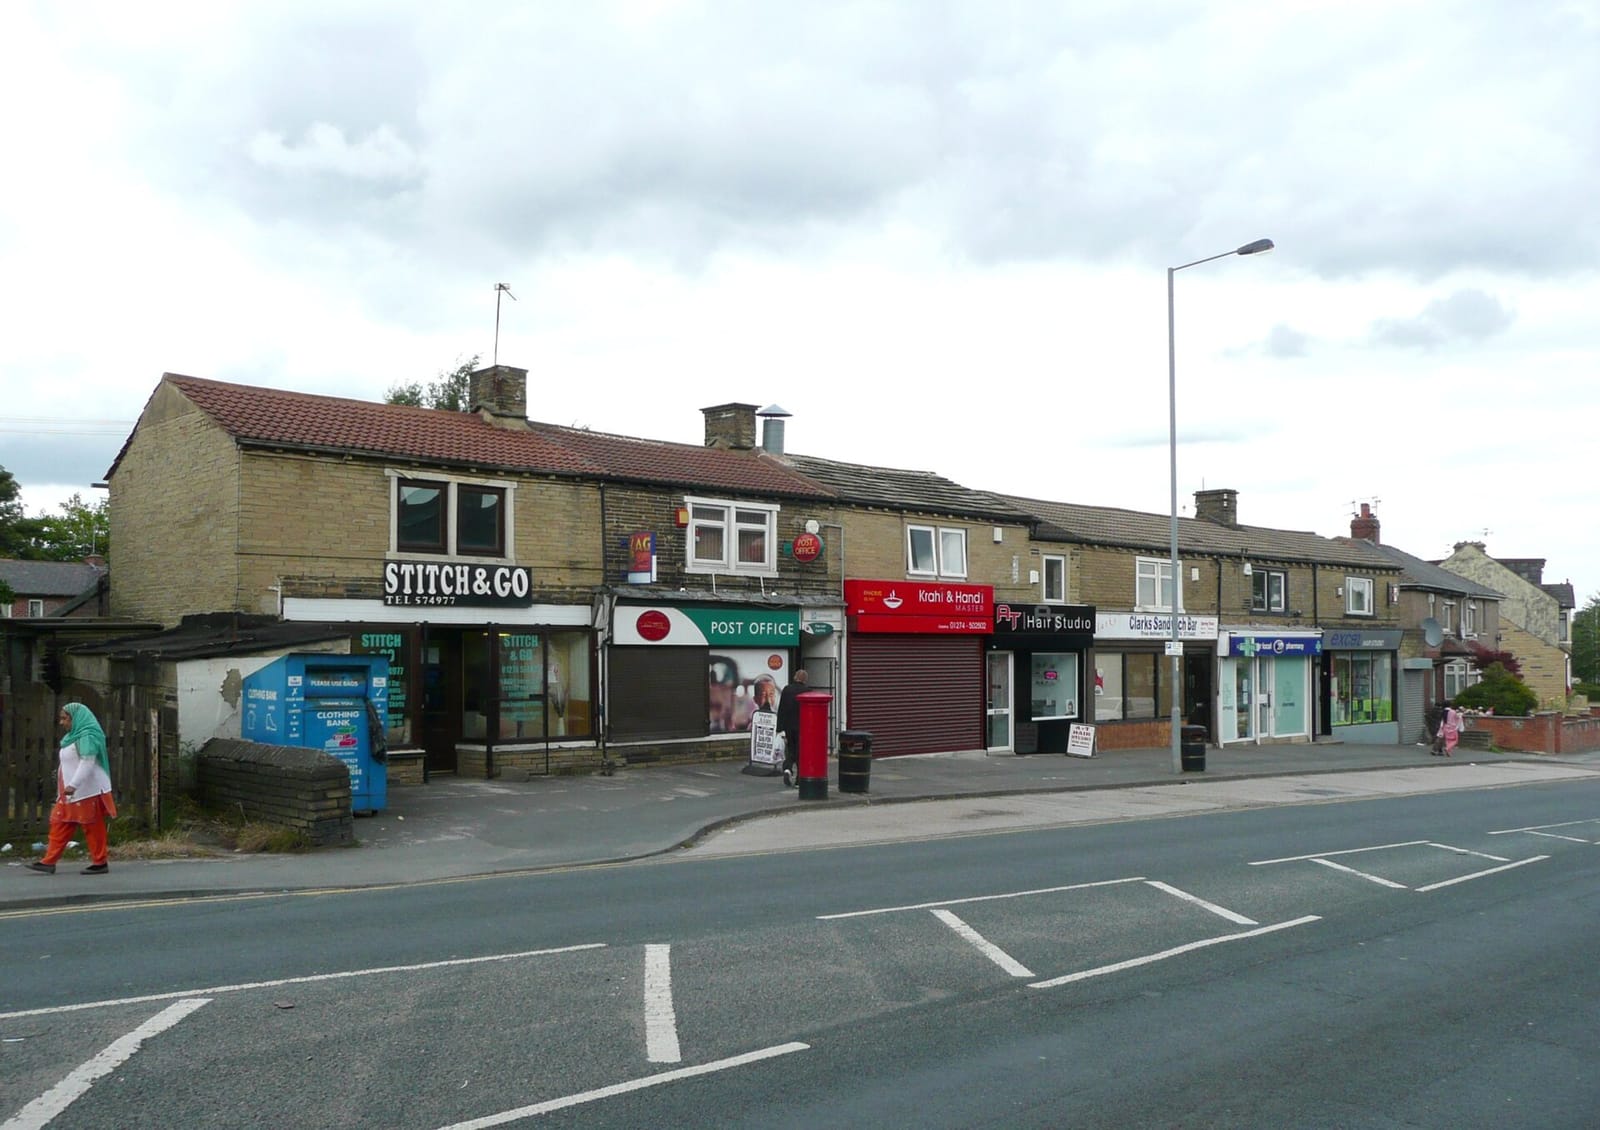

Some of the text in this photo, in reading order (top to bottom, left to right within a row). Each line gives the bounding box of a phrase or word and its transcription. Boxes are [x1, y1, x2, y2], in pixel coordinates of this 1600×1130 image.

[797, 538, 814, 547] POST
[795, 546, 816, 555] OFFICE
[385, 595, 456, 605] TEL 574977
[946, 591, 953, 603] &
[955, 591, 984, 604] Handi
[955, 604, 984, 612] MASTER
[1027, 616, 1051, 629] Hair
[1055, 615, 1091, 629] Studio
[1129, 616, 1152, 630] Clarks
[1153, 616, 1186, 630] Sandch
[1188, 617, 1197, 631] Bar
[711, 621, 795, 636] POST OFFICE
[361, 633, 402, 648] STITCH
[503, 634, 539, 648] STITCH
[519, 649, 534, 661] GO
[316, 711, 360, 719] CLOTHING
[326, 719, 351, 727] BANK
